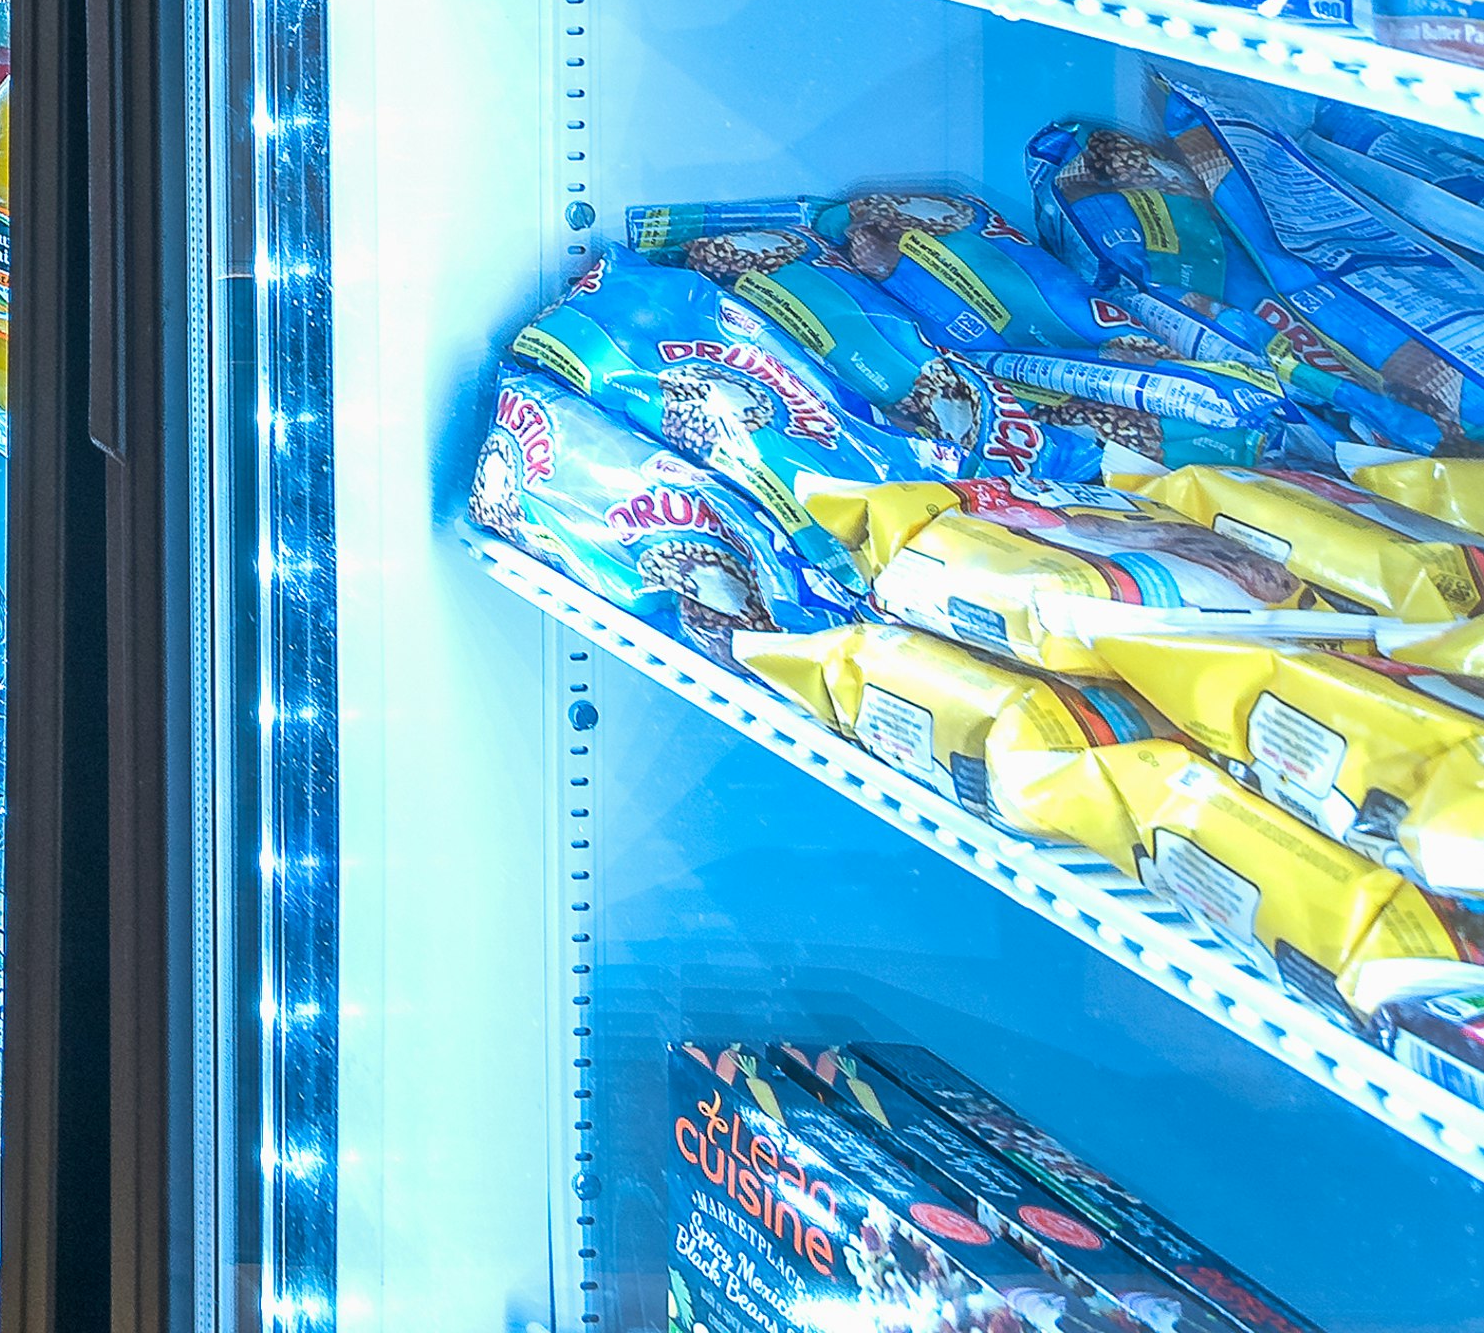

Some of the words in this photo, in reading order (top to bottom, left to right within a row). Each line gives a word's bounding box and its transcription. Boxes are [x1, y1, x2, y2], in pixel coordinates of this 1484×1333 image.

[850, 351, 889, 392] Vanilla
[675, 1222, 723, 1289] Black
[689, 1211, 735, 1274] Spicy
[695, 1190, 808, 1296] MARKETPLACE
